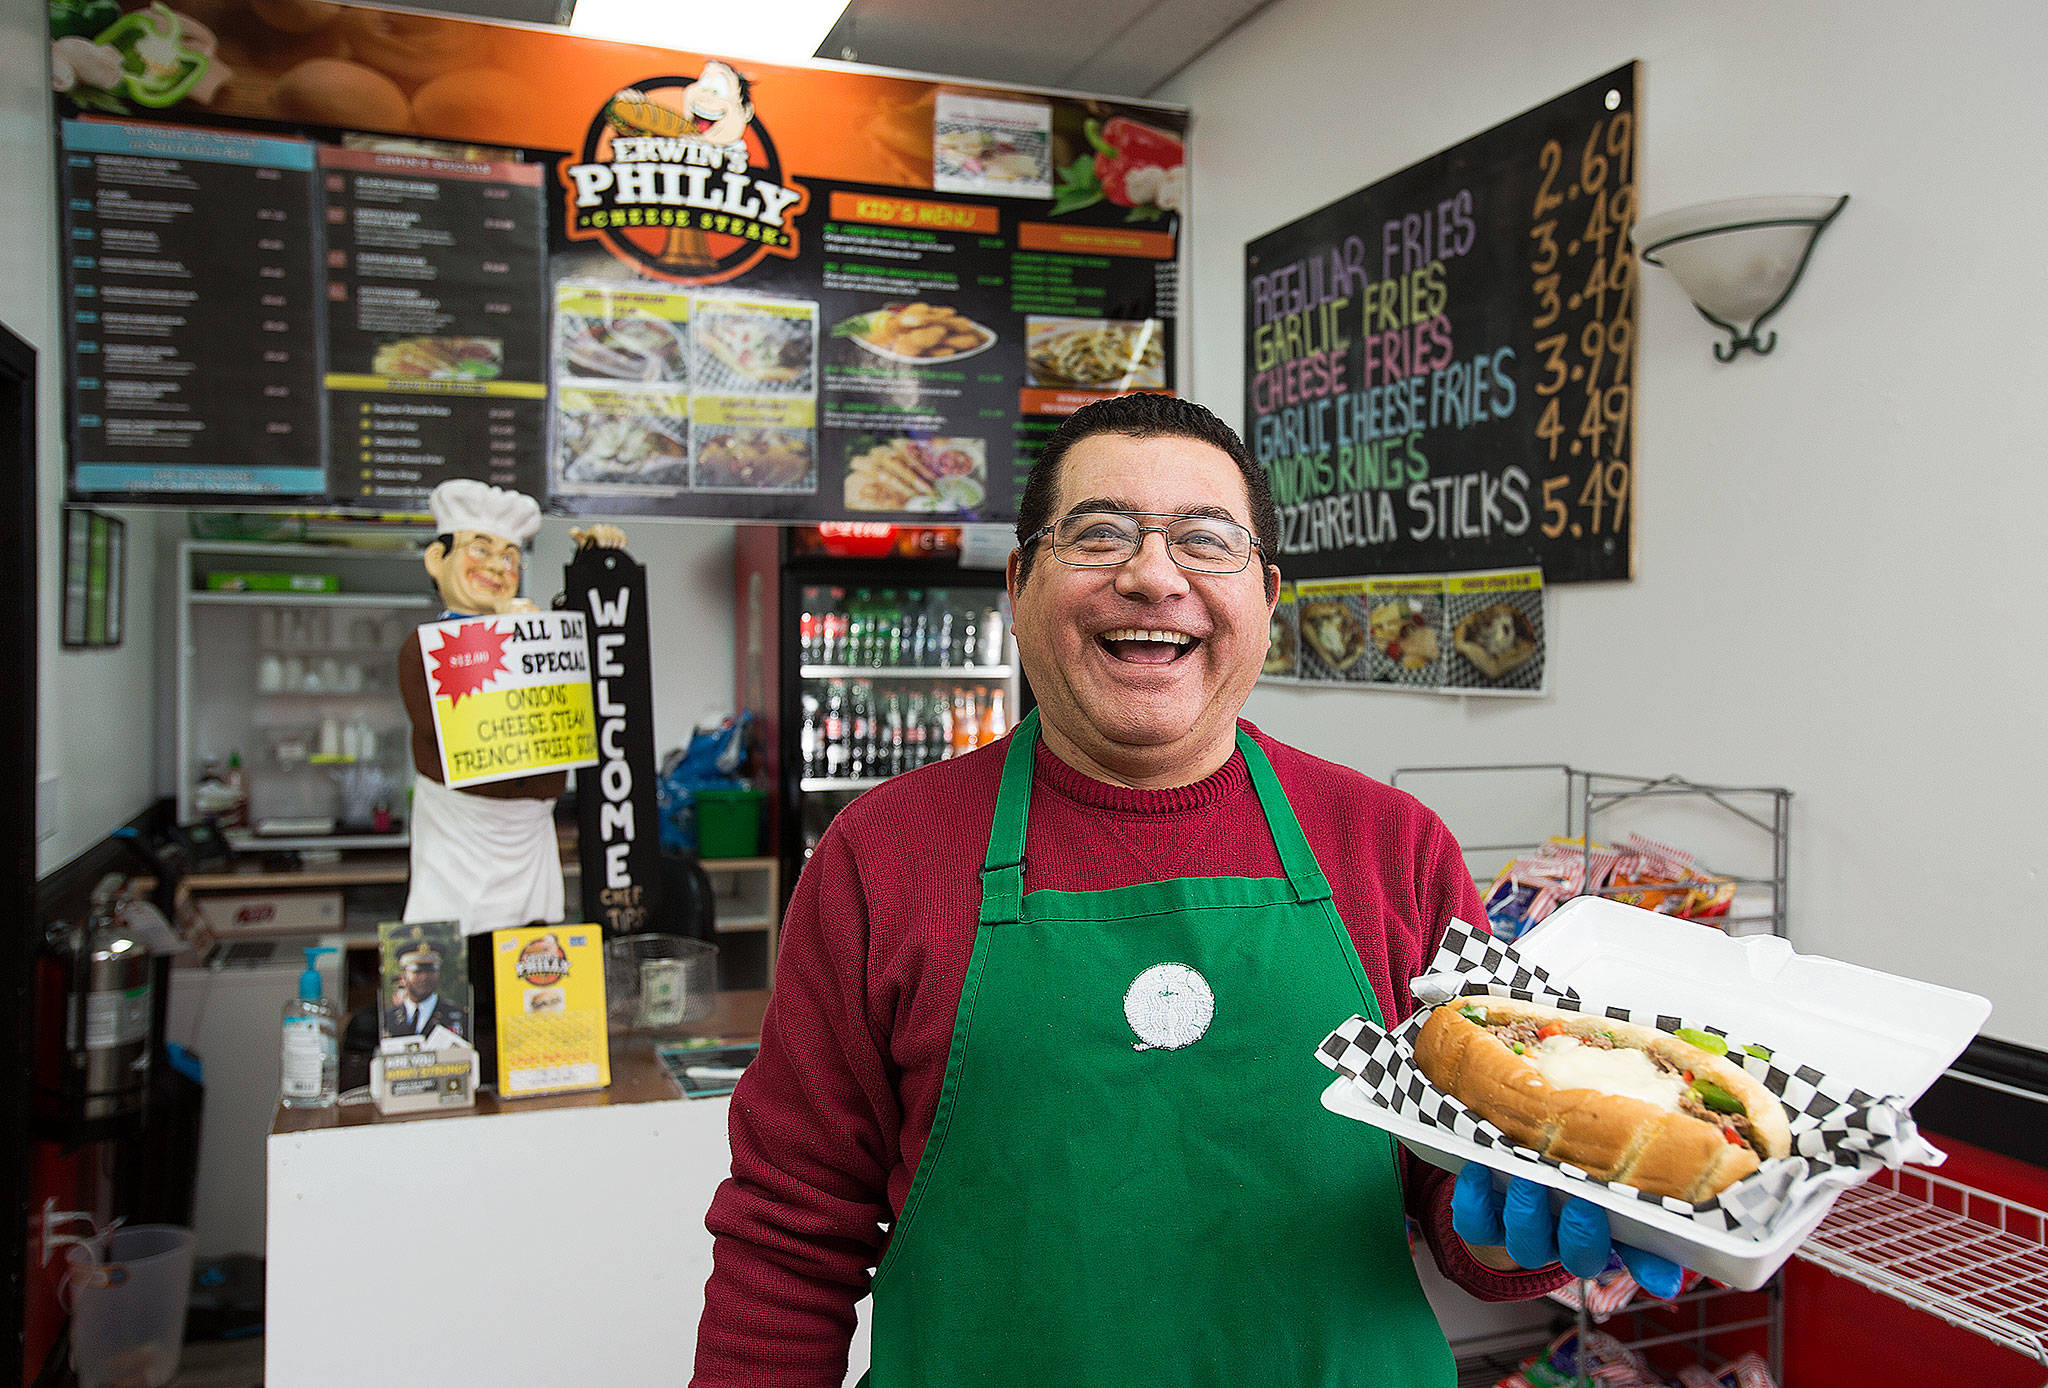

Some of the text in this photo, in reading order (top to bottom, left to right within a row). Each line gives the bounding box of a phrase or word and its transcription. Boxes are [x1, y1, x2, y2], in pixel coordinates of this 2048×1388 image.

[611, 136, 749, 174] ERWIN'S
[569, 162, 801, 227] PHILLY
[591, 207, 780, 246] CHEESE STEAK
[917, 206, 977, 228] MENU
[1252, 234, 1368, 328] REGULAR
[1382, 188, 1476, 282] FRIES
[1532, 111, 1632, 221] 2.69
[1253, 183, 1634, 373] GARLIC FRIES 3.49
[1252, 252, 1632, 416] CHEESE FRIES 3.49
[1253, 317, 1631, 464] GARLIC CHEESE FRIES 3.99
[1339, 431, 1431, 494] RINGS
[1534, 383, 1630, 462] 4.49
[1407, 464, 1532, 542] STICKS
[1540, 458, 1631, 540] 5.49
[512, 620, 552, 642] ALL
[453, 742, 532, 773] FRENCH
[477, 712, 548, 742] CHEESE
[587, 585, 636, 890] WELCOME
